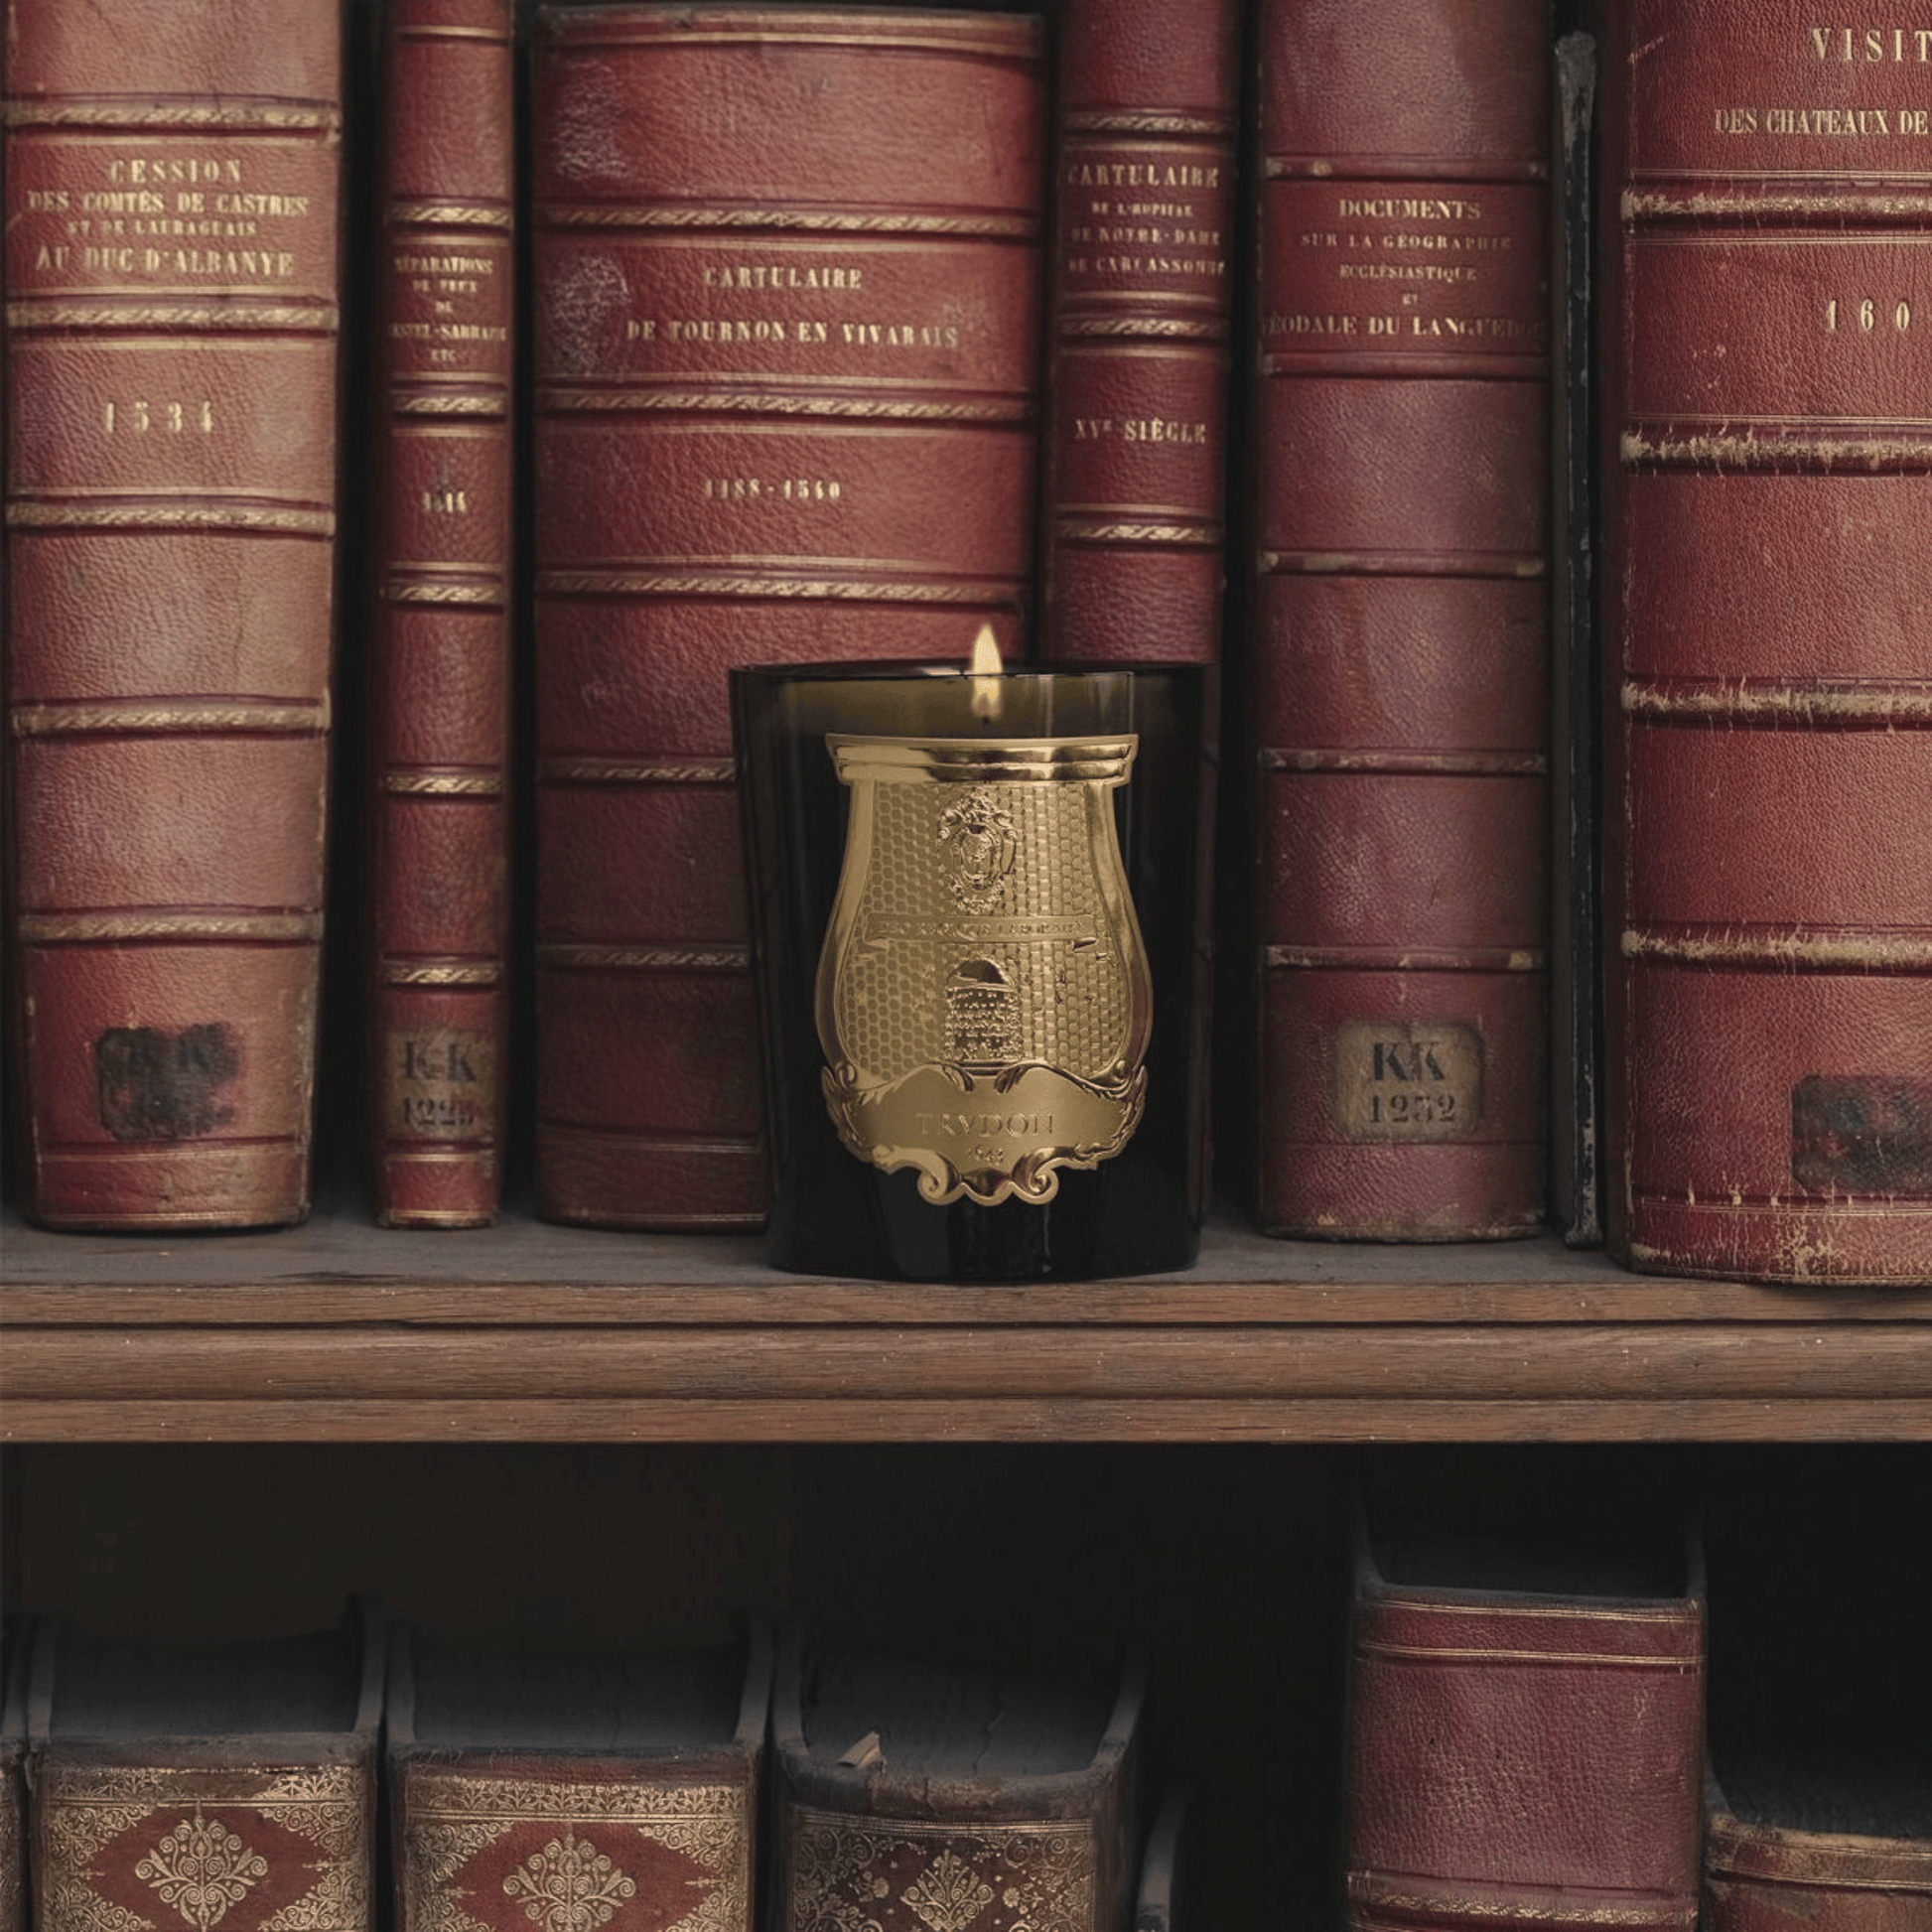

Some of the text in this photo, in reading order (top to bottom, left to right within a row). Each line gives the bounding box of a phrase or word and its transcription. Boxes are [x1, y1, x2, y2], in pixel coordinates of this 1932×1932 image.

[1715, 108, 1929, 135] DES CHATEAUX DE
[110, 159, 241, 183] CESSION
[27, 190, 69, 211] DES
[177, 192, 205, 213] DE
[216, 193, 310, 216] CASTRES
[1339, 199, 1482, 219] DOCUMENTS
[1301, 231, 1337, 247] SUR
[1348, 232, 1373, 247] LA
[36, 246, 70, 271] AU
[85, 247, 133, 272] DUC
[705, 265, 863, 290] CARTULAIRE
[626, 320, 959, 348] DE TOURNON EN VIVARAIS
[1368, 316, 1400, 336] DU
